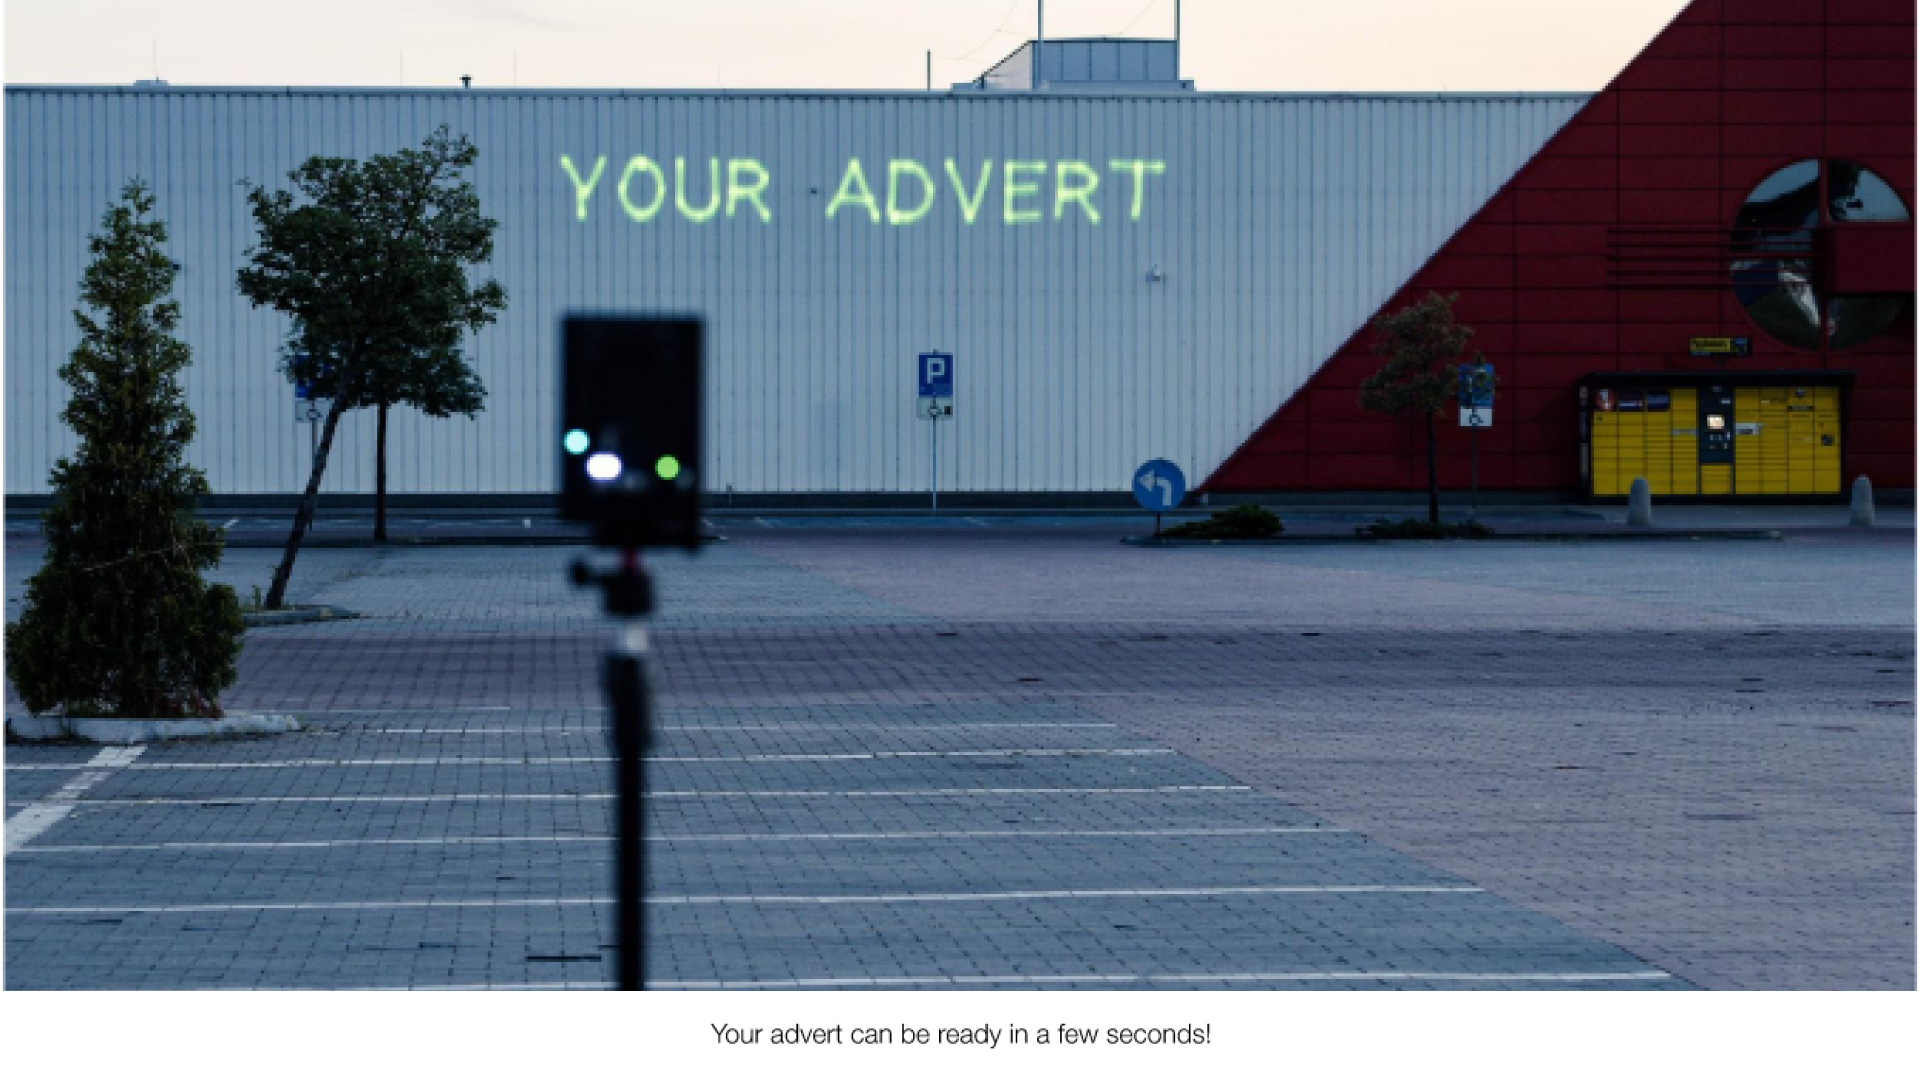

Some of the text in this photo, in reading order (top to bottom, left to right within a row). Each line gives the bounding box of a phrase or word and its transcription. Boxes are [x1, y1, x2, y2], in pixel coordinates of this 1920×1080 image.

[560, 154, 1166, 225] YOUR ADVERT
[927, 357, 945, 384] P
